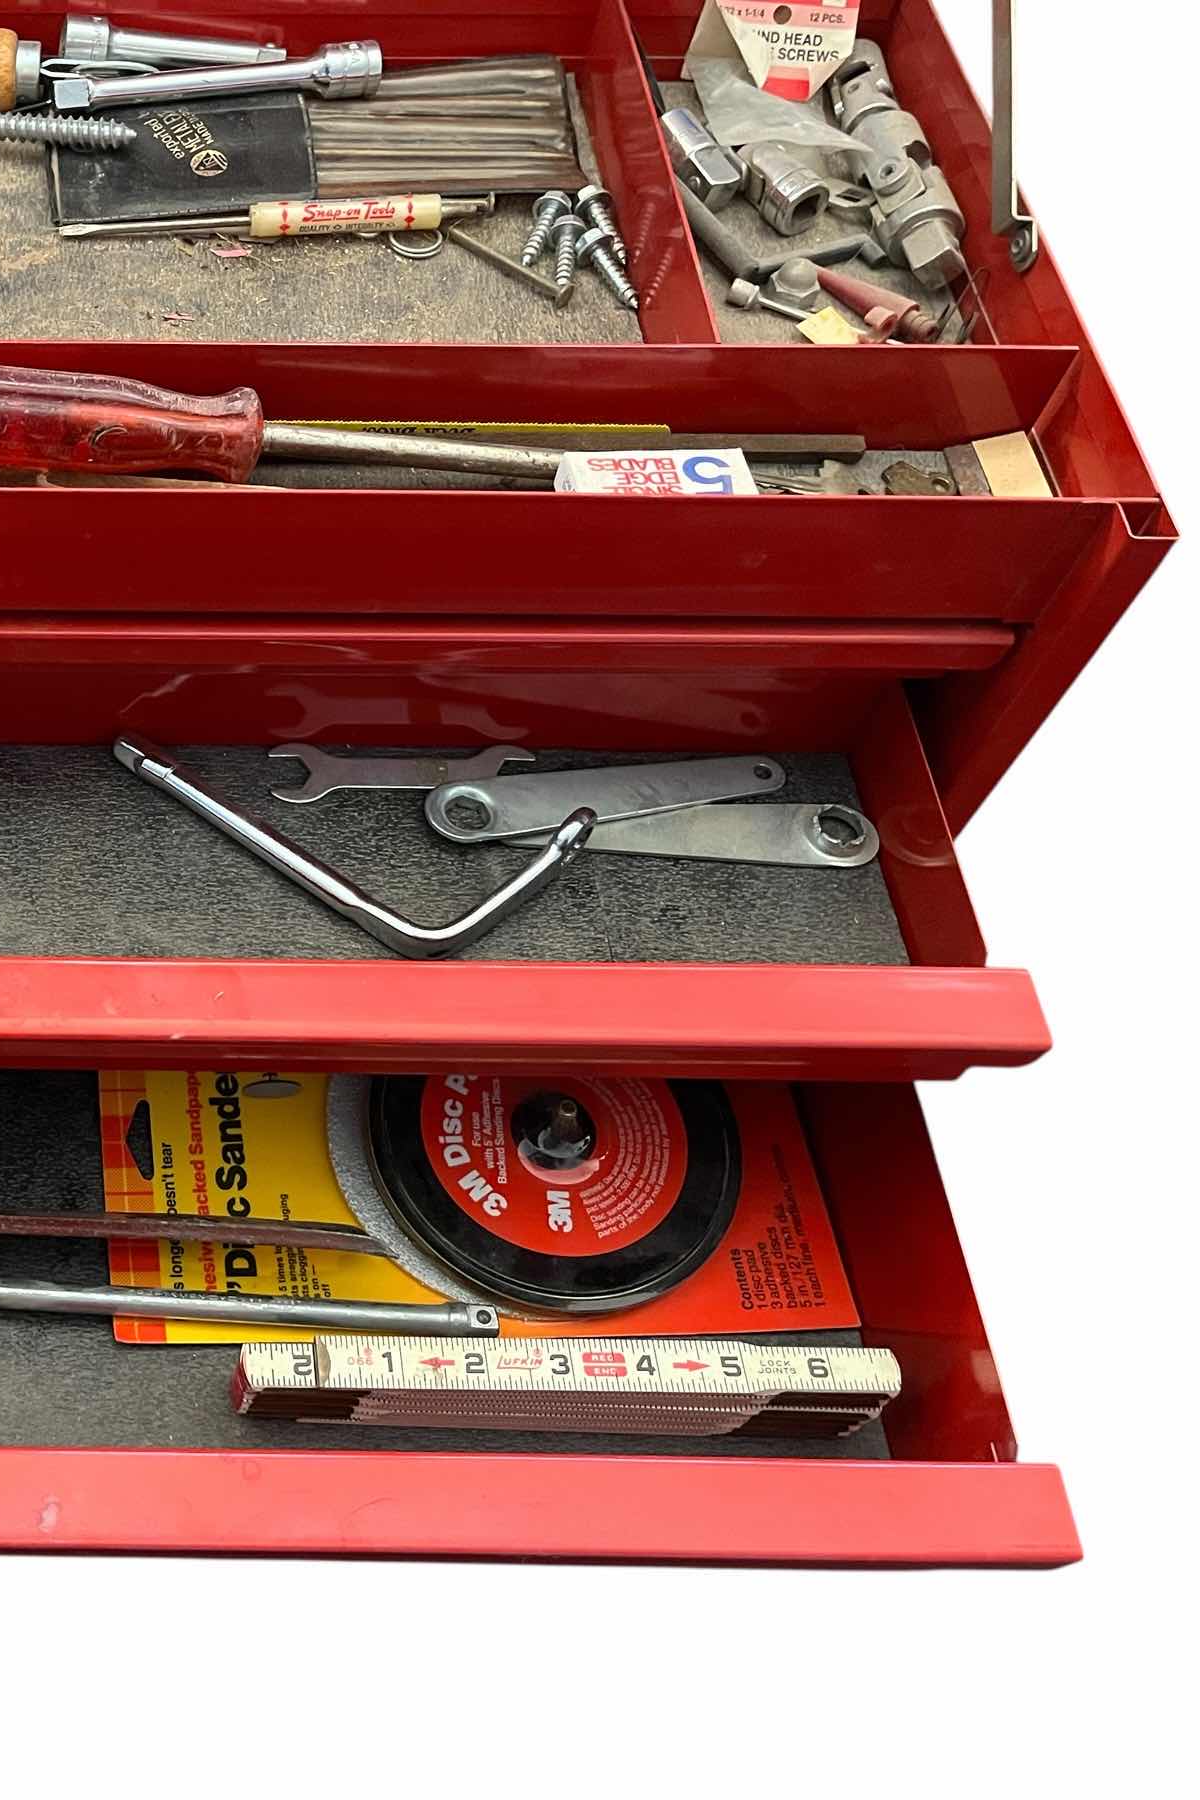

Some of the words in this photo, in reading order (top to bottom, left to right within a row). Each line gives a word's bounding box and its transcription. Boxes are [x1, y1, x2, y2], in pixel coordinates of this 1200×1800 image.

[810, 13, 820, 22] 12
[821, 13, 846, 24] PCS.
[784, 33, 823, 47] HEAD
[777, 47, 840, 63] SCREWS
[143, 118, 186, 160] exported
[194, 121, 215, 145] MADE
[302, 203, 361, 223] Snap-on
[362, 201, 396, 221] Tools
[299, 224, 331, 234] QUALITY
[345, 222, 385, 232] INTEGRITY
[586, 457, 676, 472] BLADES
[682, 456, 734, 495] 5
[615, 472, 681, 486] EDGE
[186, 1072, 205, 1156] Sandpap
[471, 1111, 480, 1132] use
[493, 1105, 505, 1146] Sanding
[208, 1072, 249, 1191] Sande
[438, 1098, 471, 1167] Disc
[471, 1132, 481, 1147] For
[161, 1142, 173, 1170] tear
[484, 1147, 495, 1169] with
[496, 1147, 508, 1184] Backed
[162, 1171, 178, 1217] oesn't
[190, 1160, 210, 1217] acked
[457, 1169, 508, 1217] 3M
[546, 1190, 574, 1233] 3M
[592, 1213, 625, 1231] Sanding
[597, 1225, 619, 1239] parts
[626, 1212, 640, 1225] the
[637, 1196, 655, 1215] body
[222, 1196, 258, 1278] Dic
[766, 1226, 784, 1260] discs
[169, 1239, 184, 1279] longe
[744, 1249, 761, 1274] pad
[757, 1241, 780, 1299] adhesive
[311, 1277, 320, 1291] on
[321, 1284, 332, 1298] off
[730, 1248, 755, 1311] Contents
[750, 1275, 766, 1302] disc
[776, 1262, 798, 1309] backed
[806, 1268, 824, 1299] each
[770, 1300, 784, 1310] 3
[799, 1299, 813, 1309] 5
[381, 1351, 394, 1373] 1
[464, 1352, 486, 1375] 2
[495, 1353, 544, 1370] LUFKIN
[549, 1353, 571, 1376] 3
[591, 1353, 615, 1362] RED
[635, 1354, 657, 1376] 4
[719, 1356, 743, 1378] 5
[759, 1359, 791, 1367] LOCK
[806, 1357, 830, 1379] 6
[593, 1367, 617, 1376] END
[758, 1367, 797, 1375] JOINTS
